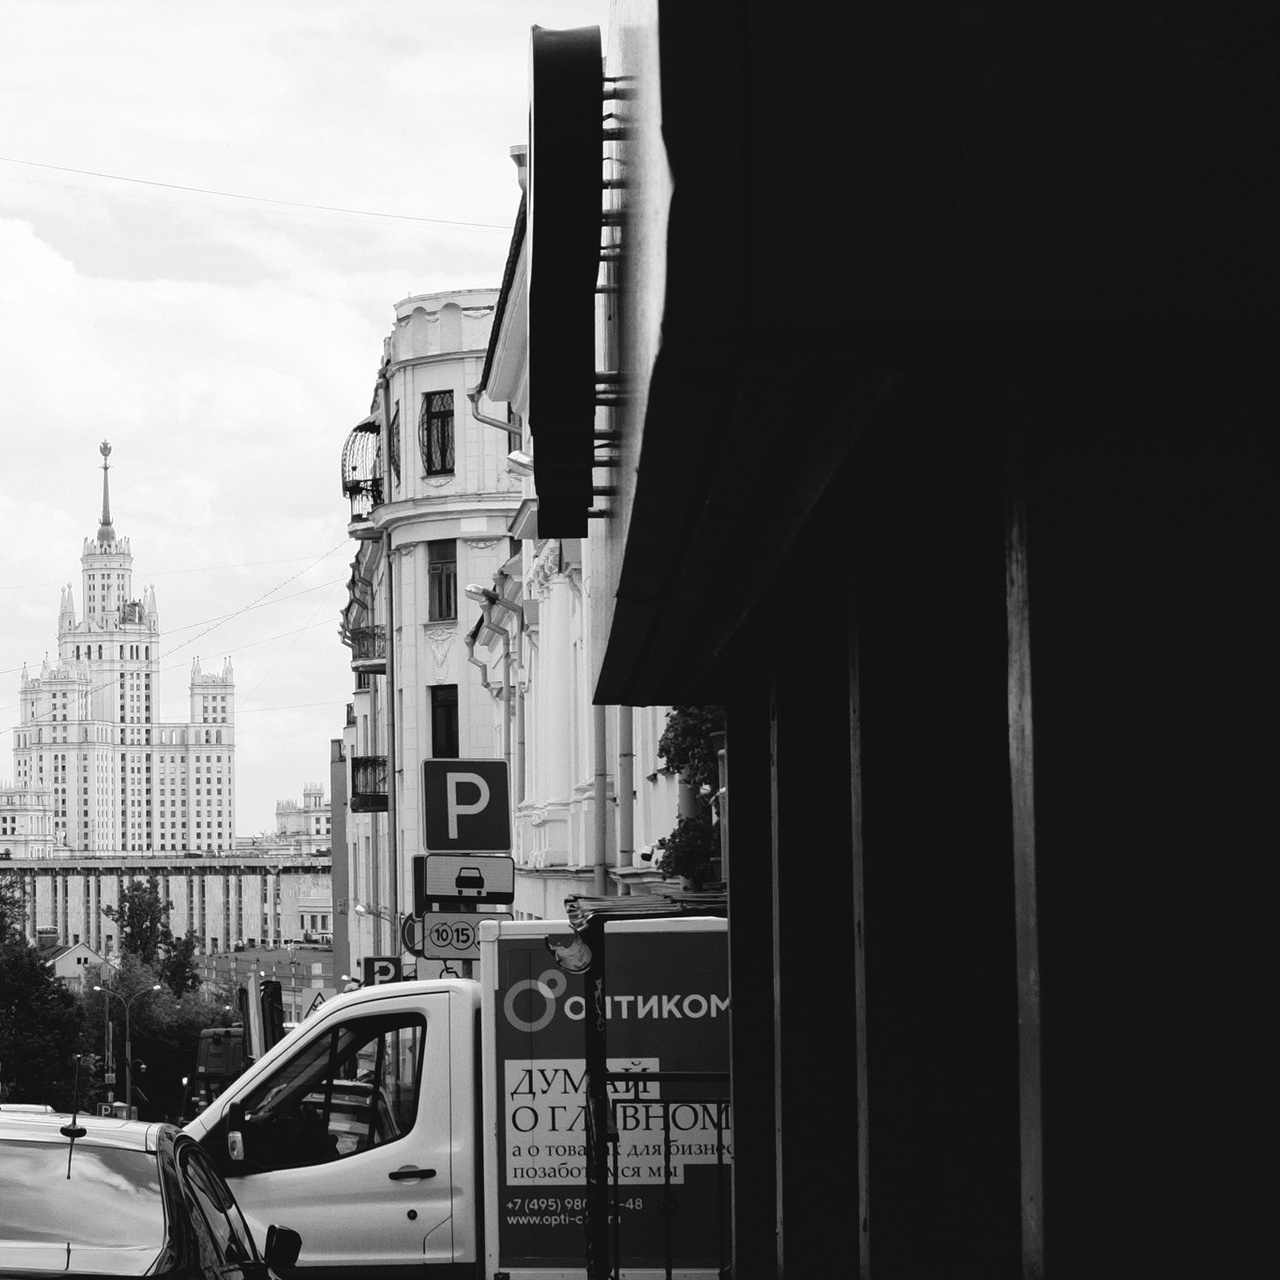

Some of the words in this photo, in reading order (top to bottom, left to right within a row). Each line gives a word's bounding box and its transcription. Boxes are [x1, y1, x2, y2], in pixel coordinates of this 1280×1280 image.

[446, 772, 490, 839] P
[435, 927, 449, 942] 10
[454, 927, 470, 945] 15
[374, 961, 396, 985] P
[564, 994, 730, 1021] ОТИКОМ
[102, 1105, 111, 1117] P
[511, 1105, 539, 1133] О
[512, 1145, 522, 1157] а
[528, 1145, 540, 1158] о
[627, 1143, 663, 1158] для
[506, 1198, 522, 1211] +7
[524, 1198, 561, 1213] (495)
